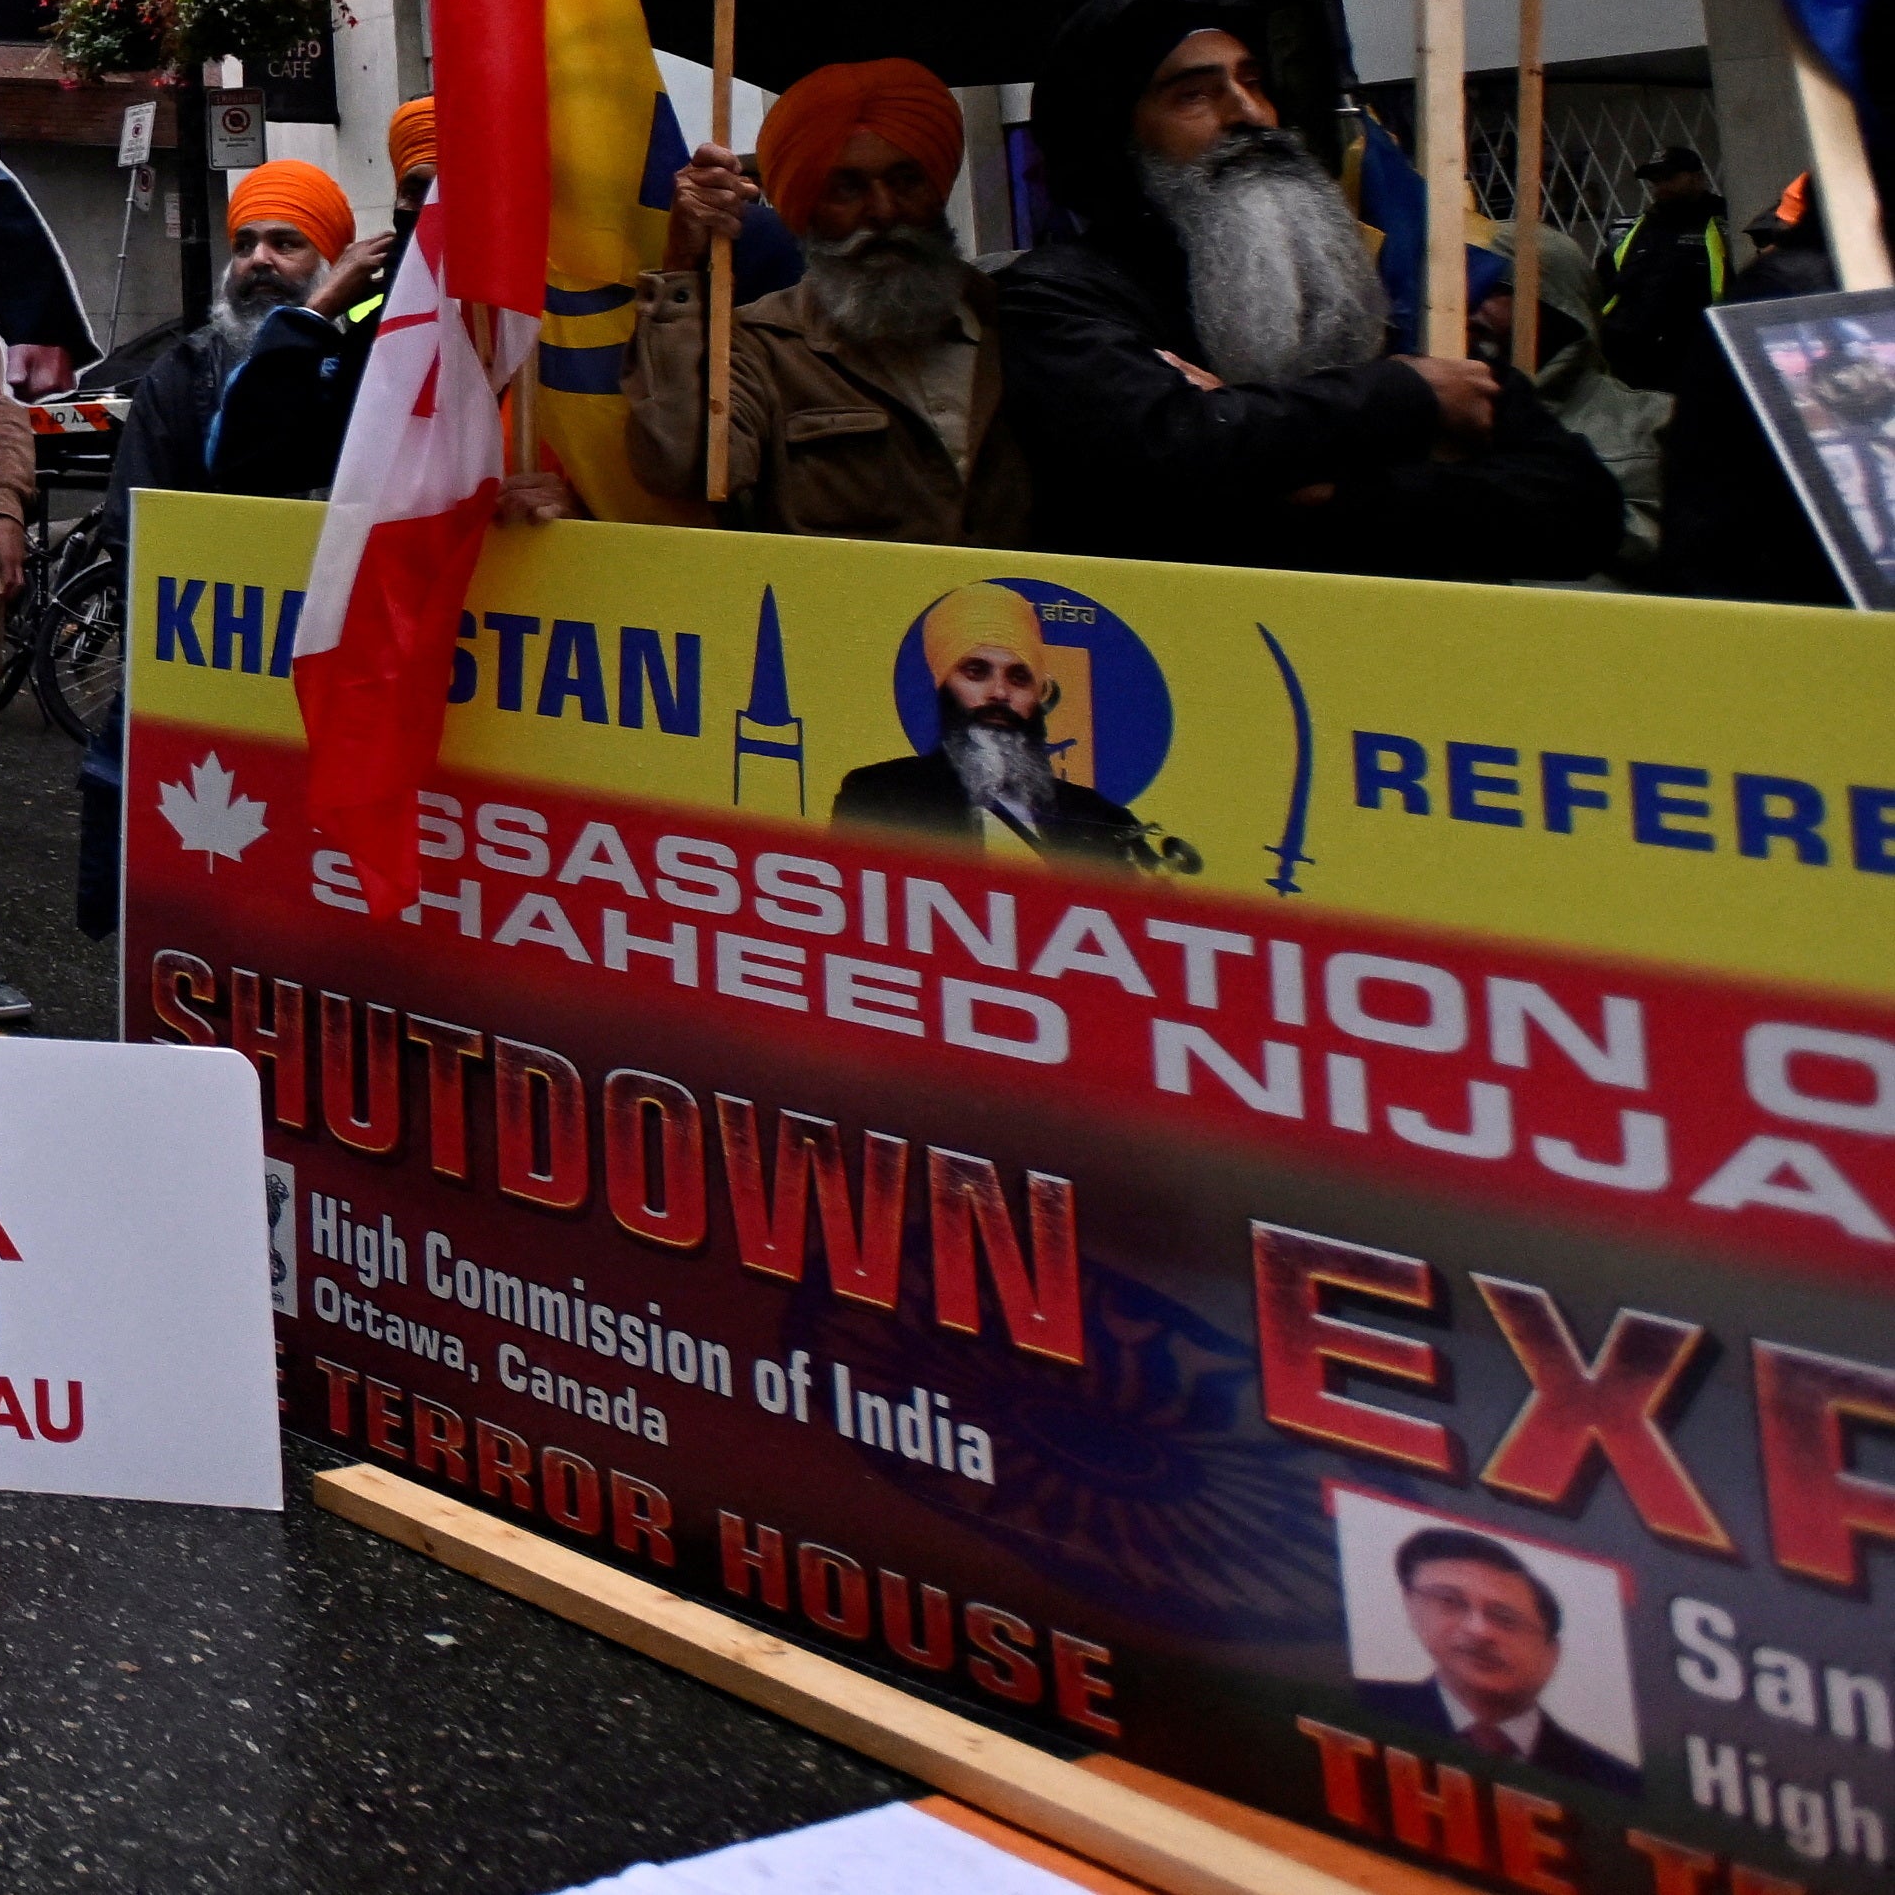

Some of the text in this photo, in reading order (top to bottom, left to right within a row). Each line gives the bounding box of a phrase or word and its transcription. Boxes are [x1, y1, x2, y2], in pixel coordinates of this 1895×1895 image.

[417, 790, 1648, 1092] SSASSINATION
[151, 949, 1084, 1366] SHUTDOWN
[311, 1192, 996, 1486] High Commission of India
[314, 1276, 481, 1384] Ottawa,
[498, 1342, 669, 1446] Canada
[315, 1356, 1121, 1738] TERROR HOUSE
[1297, 1716, 1572, 1895] THE
[1687, 1734, 1885, 1863] High
